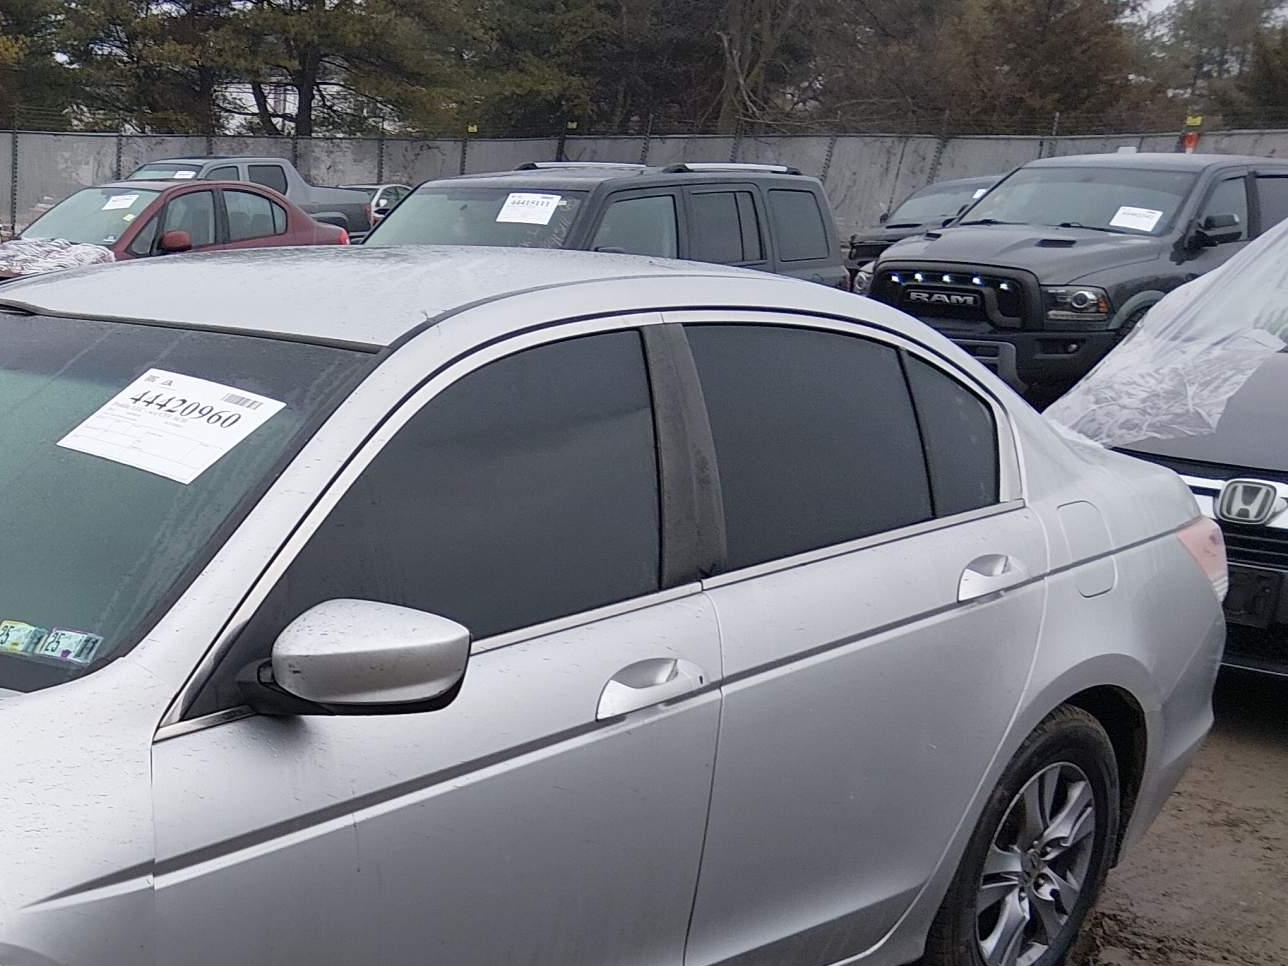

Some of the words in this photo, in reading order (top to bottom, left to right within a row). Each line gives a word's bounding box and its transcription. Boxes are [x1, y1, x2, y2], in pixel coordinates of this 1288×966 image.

[909, 292, 974, 305] RAM
[129, 390, 243, 429] 44420960
[44, 632, 66, 652] 25
